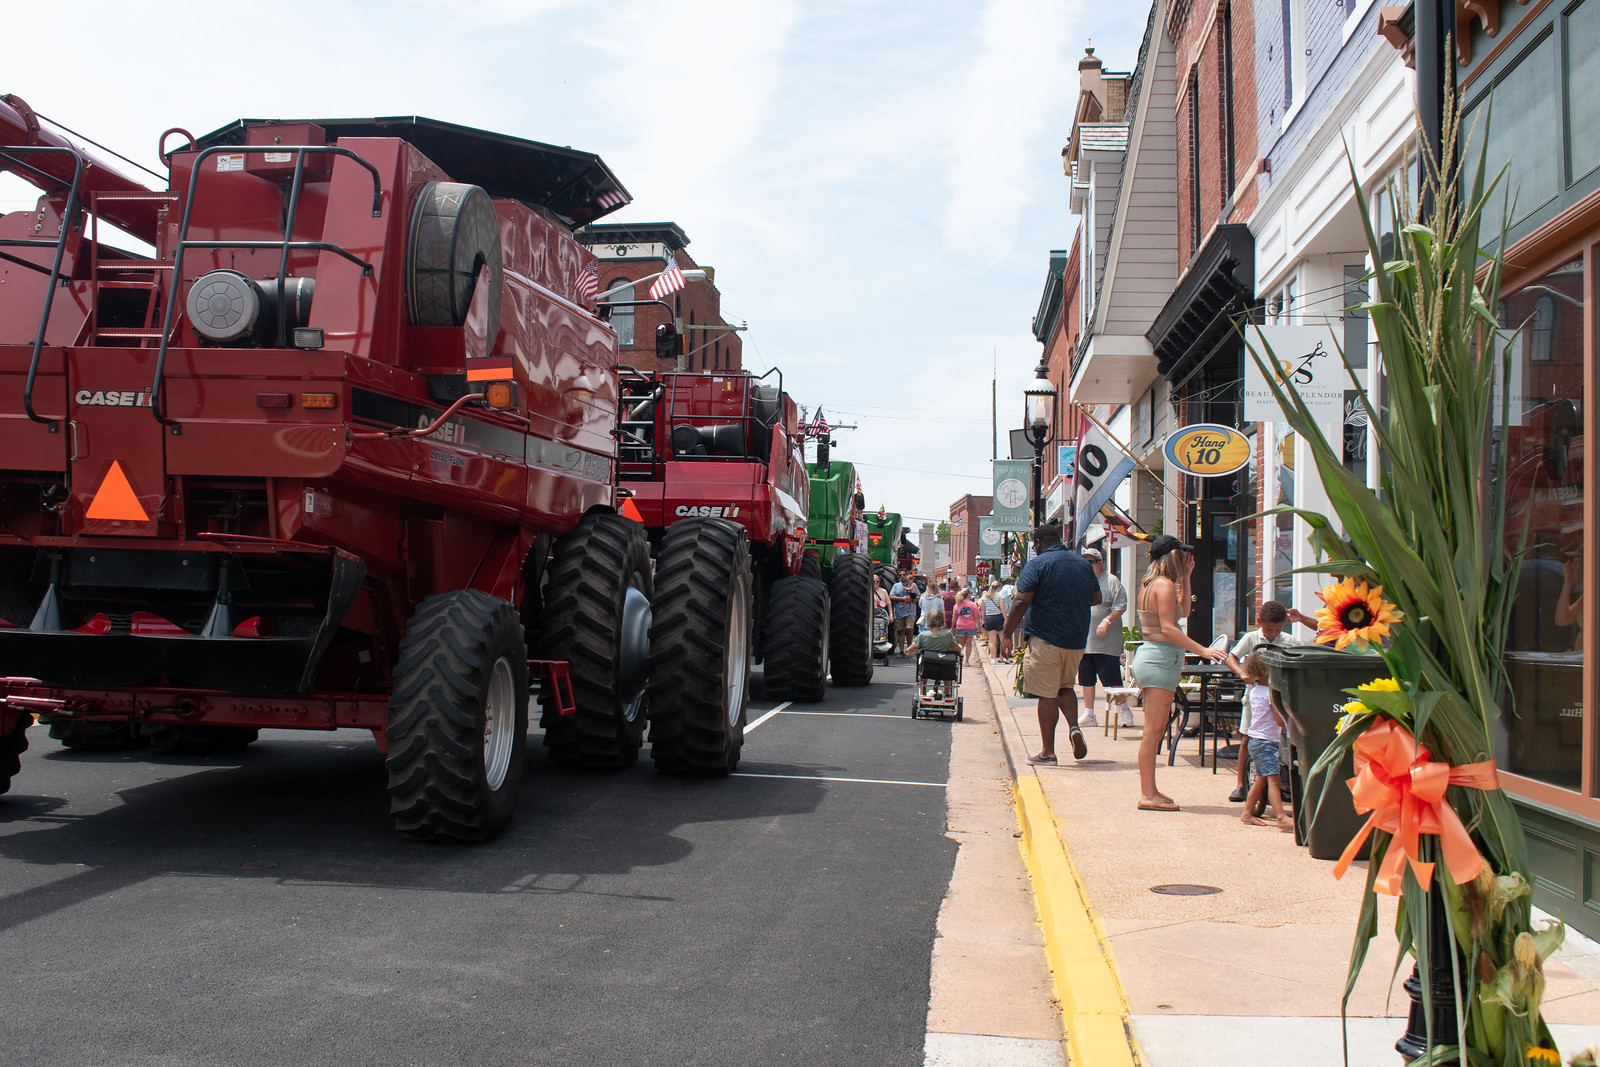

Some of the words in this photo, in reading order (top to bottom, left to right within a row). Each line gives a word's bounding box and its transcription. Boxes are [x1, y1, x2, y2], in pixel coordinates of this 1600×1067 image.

[74, 389, 136, 406] CASE
[1190, 435, 1226, 450] Hang
[429, 450, 466, 467] AXIAL-FLOW
[1194, 448, 1221, 465] 10
[996, 466, 1028, 475] DISCOVER
[675, 504, 723, 518] CASE
[1000, 515, 1023, 524] 1686
